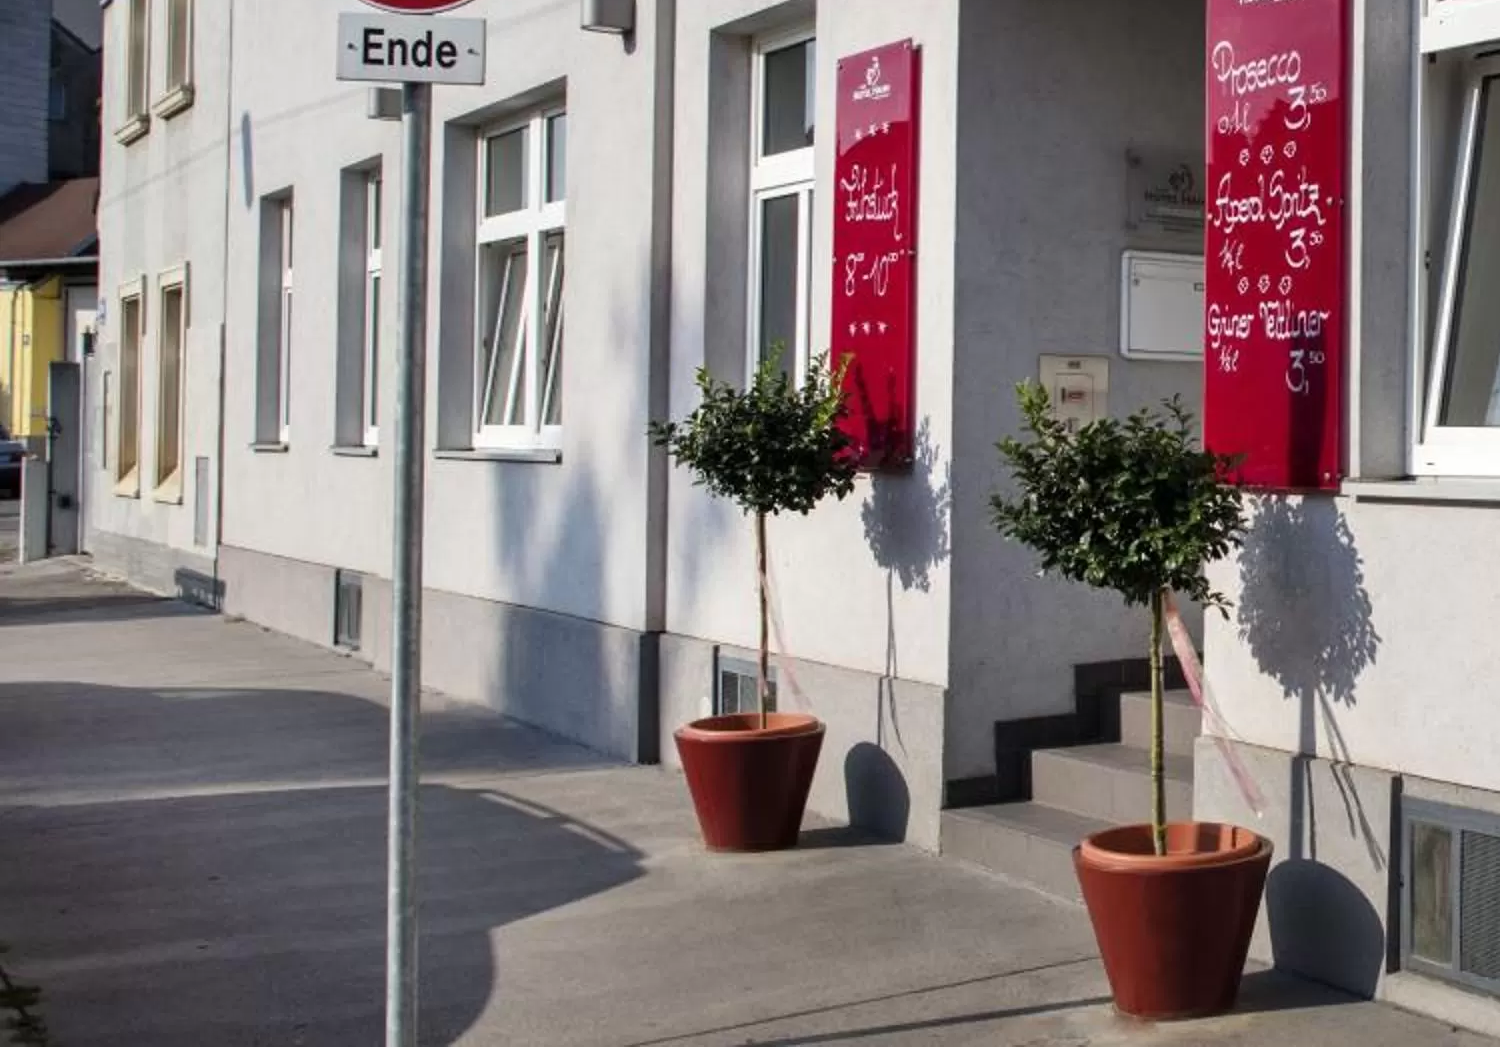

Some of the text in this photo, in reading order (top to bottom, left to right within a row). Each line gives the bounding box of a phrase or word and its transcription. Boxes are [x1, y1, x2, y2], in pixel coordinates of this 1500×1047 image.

[362, 27, 458, 69] Ende
[1212, 40, 1302, 96] Prosecco
[1213, 164, 1327, 234] Aperol Spritz
